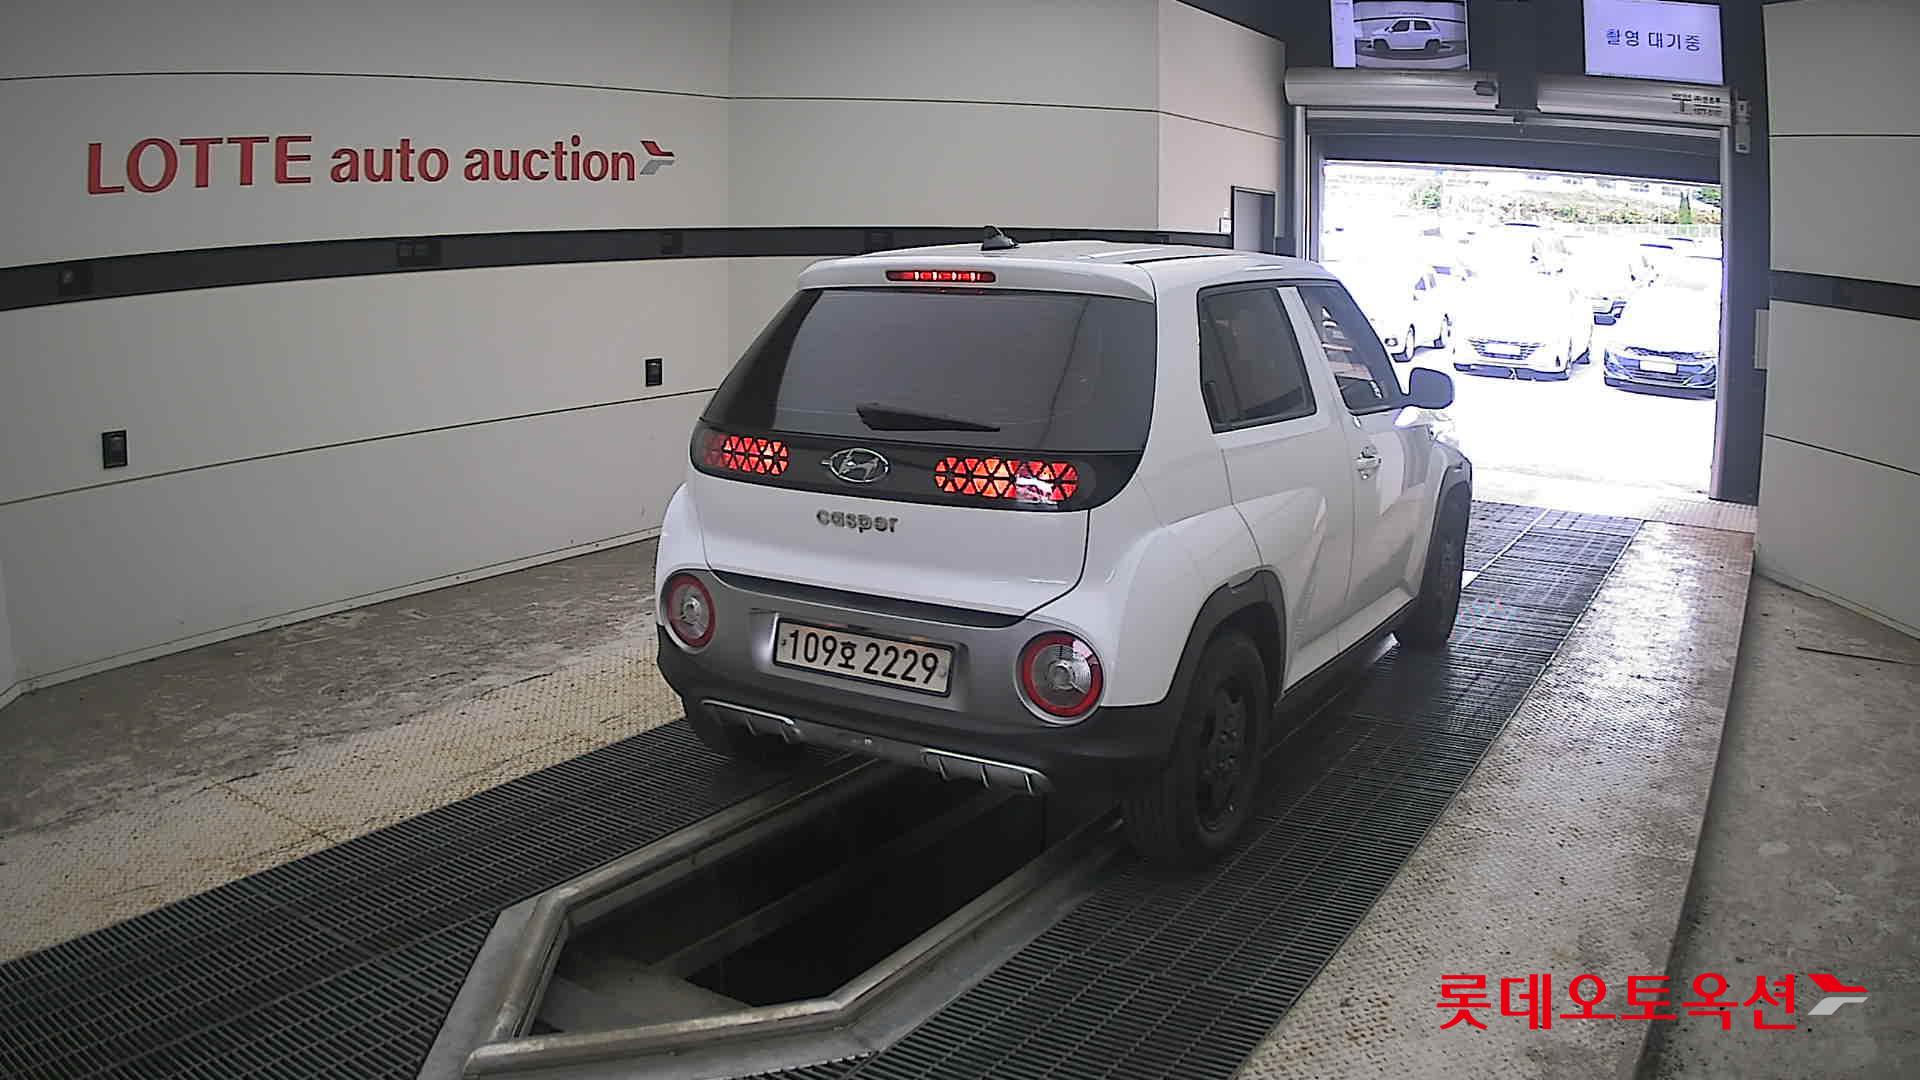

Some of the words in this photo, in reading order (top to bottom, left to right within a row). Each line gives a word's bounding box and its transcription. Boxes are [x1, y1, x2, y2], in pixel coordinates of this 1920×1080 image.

[1648, 31, 1700, 52] 대기중
[87, 135, 312, 195] LOTTE
[329, 138, 449, 183] auto
[463, 135, 636, 182] auction
